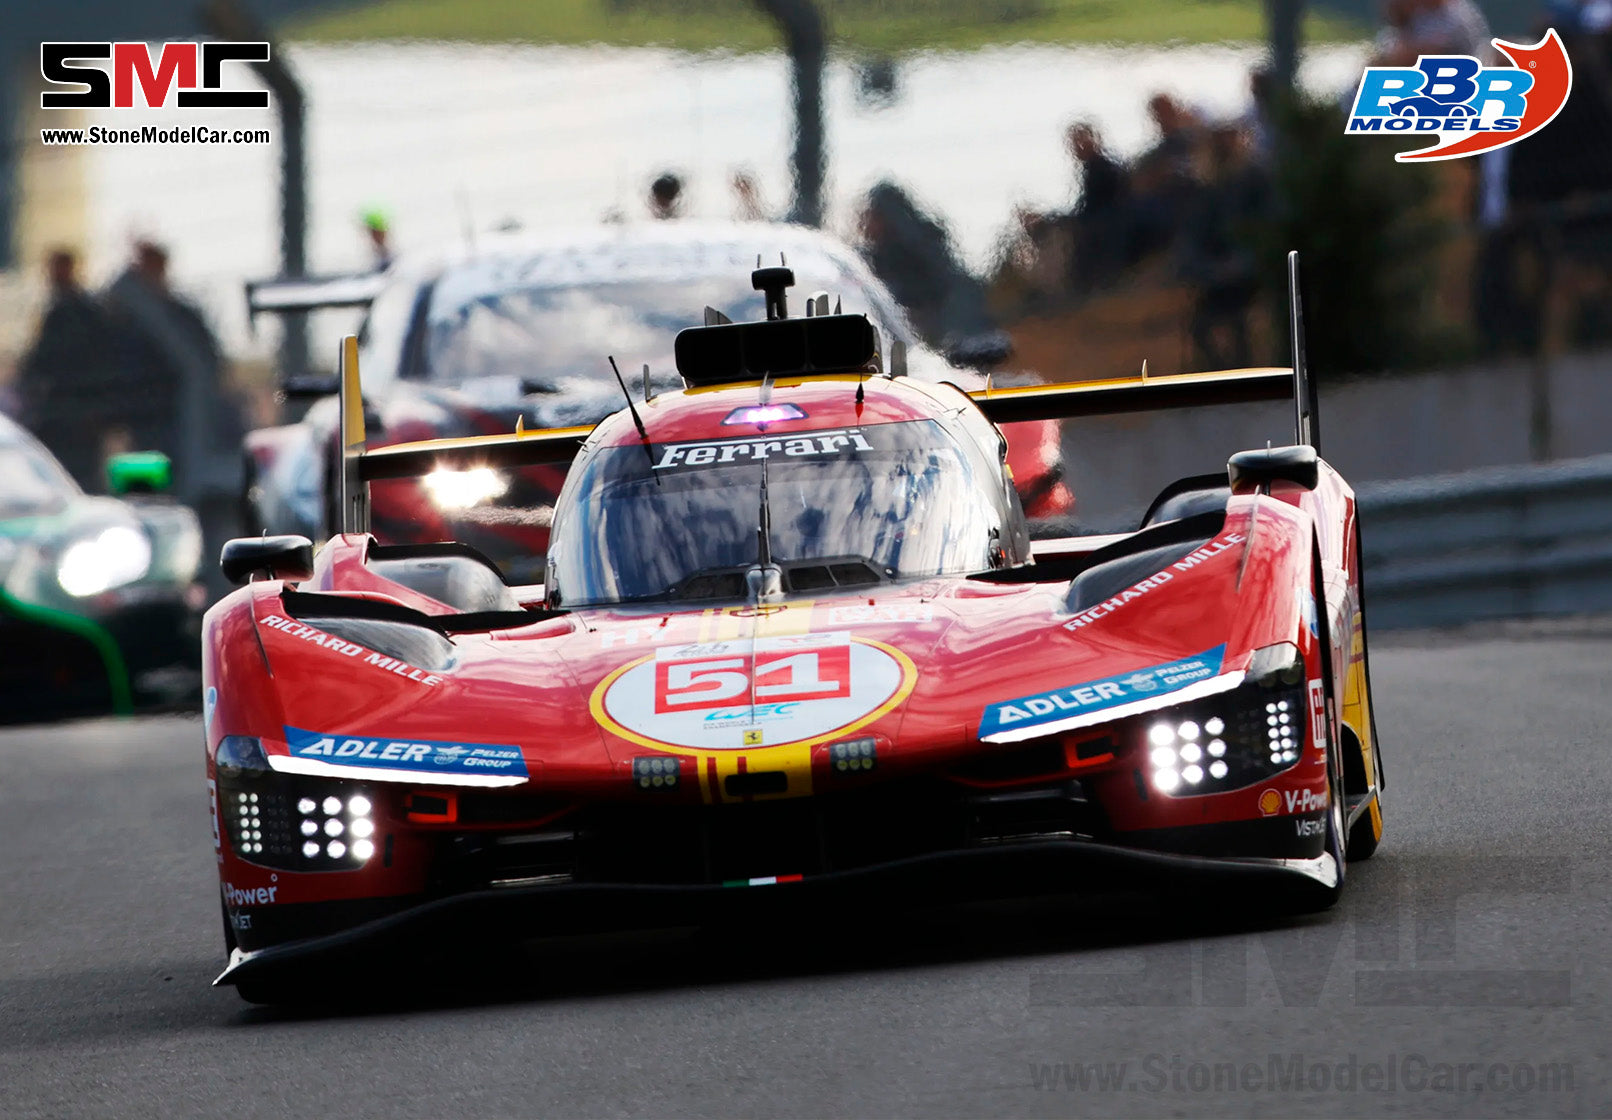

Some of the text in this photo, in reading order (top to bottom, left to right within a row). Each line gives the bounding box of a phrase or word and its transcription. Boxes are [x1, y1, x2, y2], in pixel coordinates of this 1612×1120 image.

[651, 429, 874, 469] Ferrari
[1062, 533, 1246, 631] RICHARD MILLE
[260, 615, 443, 686] RICHARD MILLE
[665, 652, 839, 706] 51
[998, 681, 1128, 724] ADLER
[300, 738, 432, 762] ADLER
